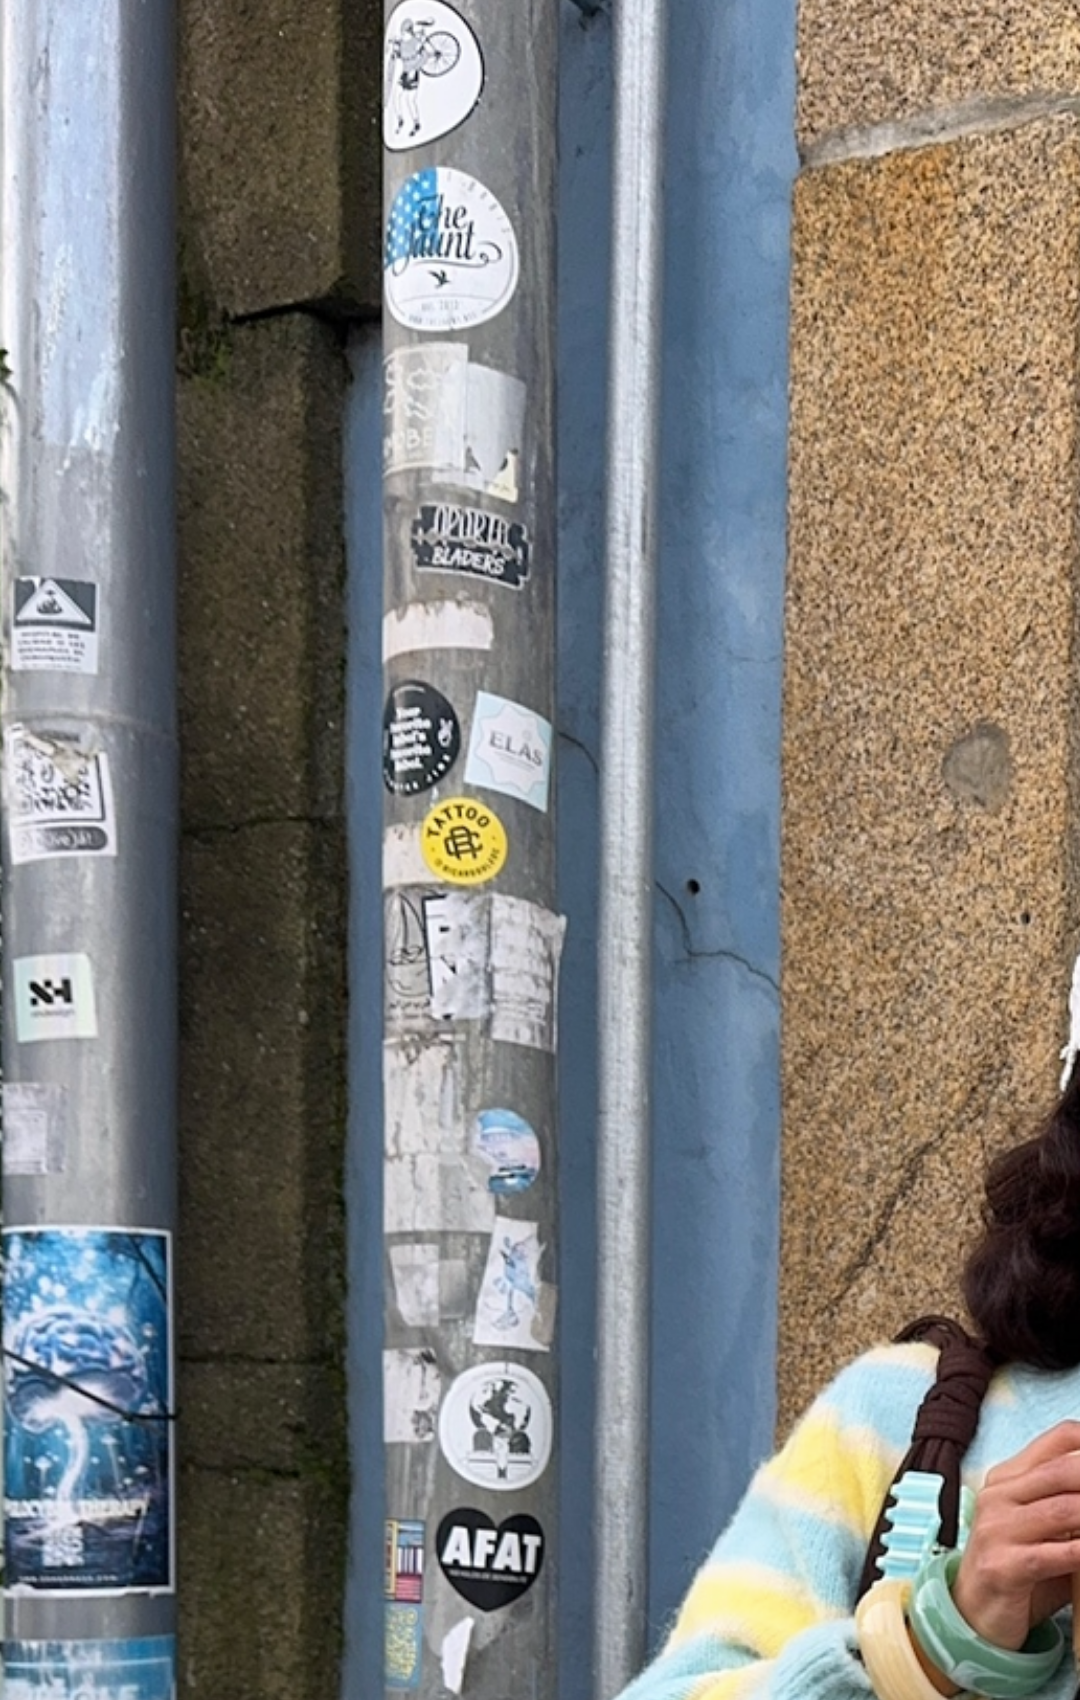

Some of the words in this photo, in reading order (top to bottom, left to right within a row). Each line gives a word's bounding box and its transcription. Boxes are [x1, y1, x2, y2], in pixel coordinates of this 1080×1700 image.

[418, 194, 467, 231] The
[432, 546, 505, 575] BLADERS
[489, 731, 543, 767] ELAS
[426, 804, 490, 838] TATTOO
[442, 1525, 542, 1574] AFAT
